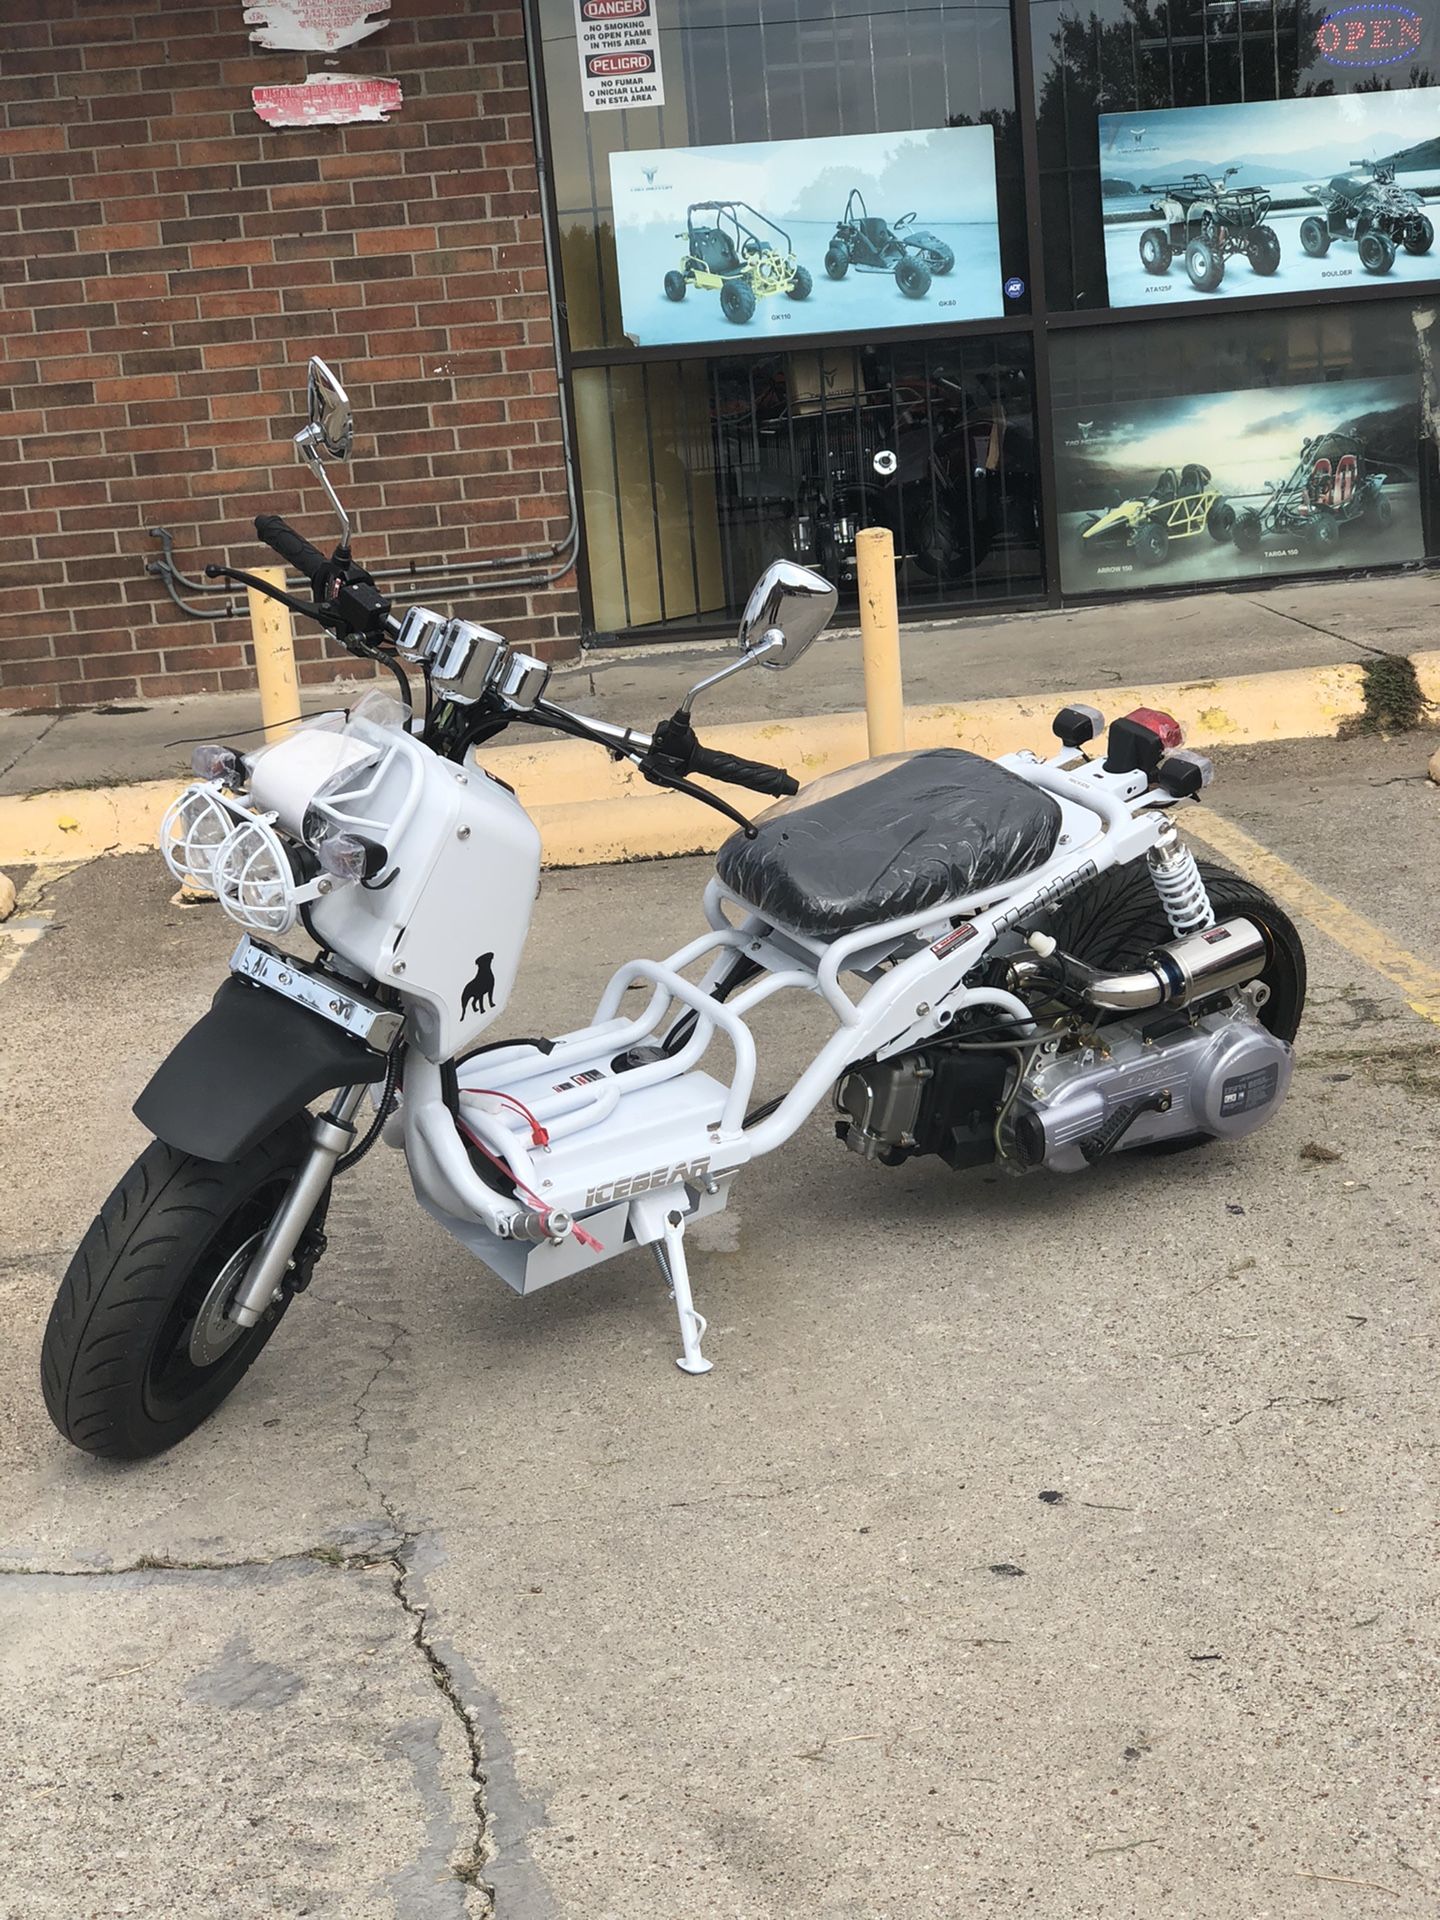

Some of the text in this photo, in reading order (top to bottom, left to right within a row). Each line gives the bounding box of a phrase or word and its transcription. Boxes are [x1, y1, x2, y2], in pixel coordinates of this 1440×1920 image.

[588, 0, 642, 16] DANGER
[589, 20, 645, 32] NO SMOKING
[583, 28, 652, 41] OR OPEN FLAME
[1317, 17, 1422, 52] OPEN
[590, 38, 647, 49] IN THIS AREA
[593, 56, 648, 71] PELIGRO
[601, 77, 644, 88] NO FUMAR
[597, 87, 628, 96] INICIAR
[630, 84, 657, 94] LLAMA
[595, 93, 653, 105] EN ESTA AREA
[1321, 269, 1353, 278] BOULDER
[771, 313, 792, 321] GK110
[1264, 549, 1299, 558] TARGA 150
[1097, 565, 1133, 574] ARROW 150
